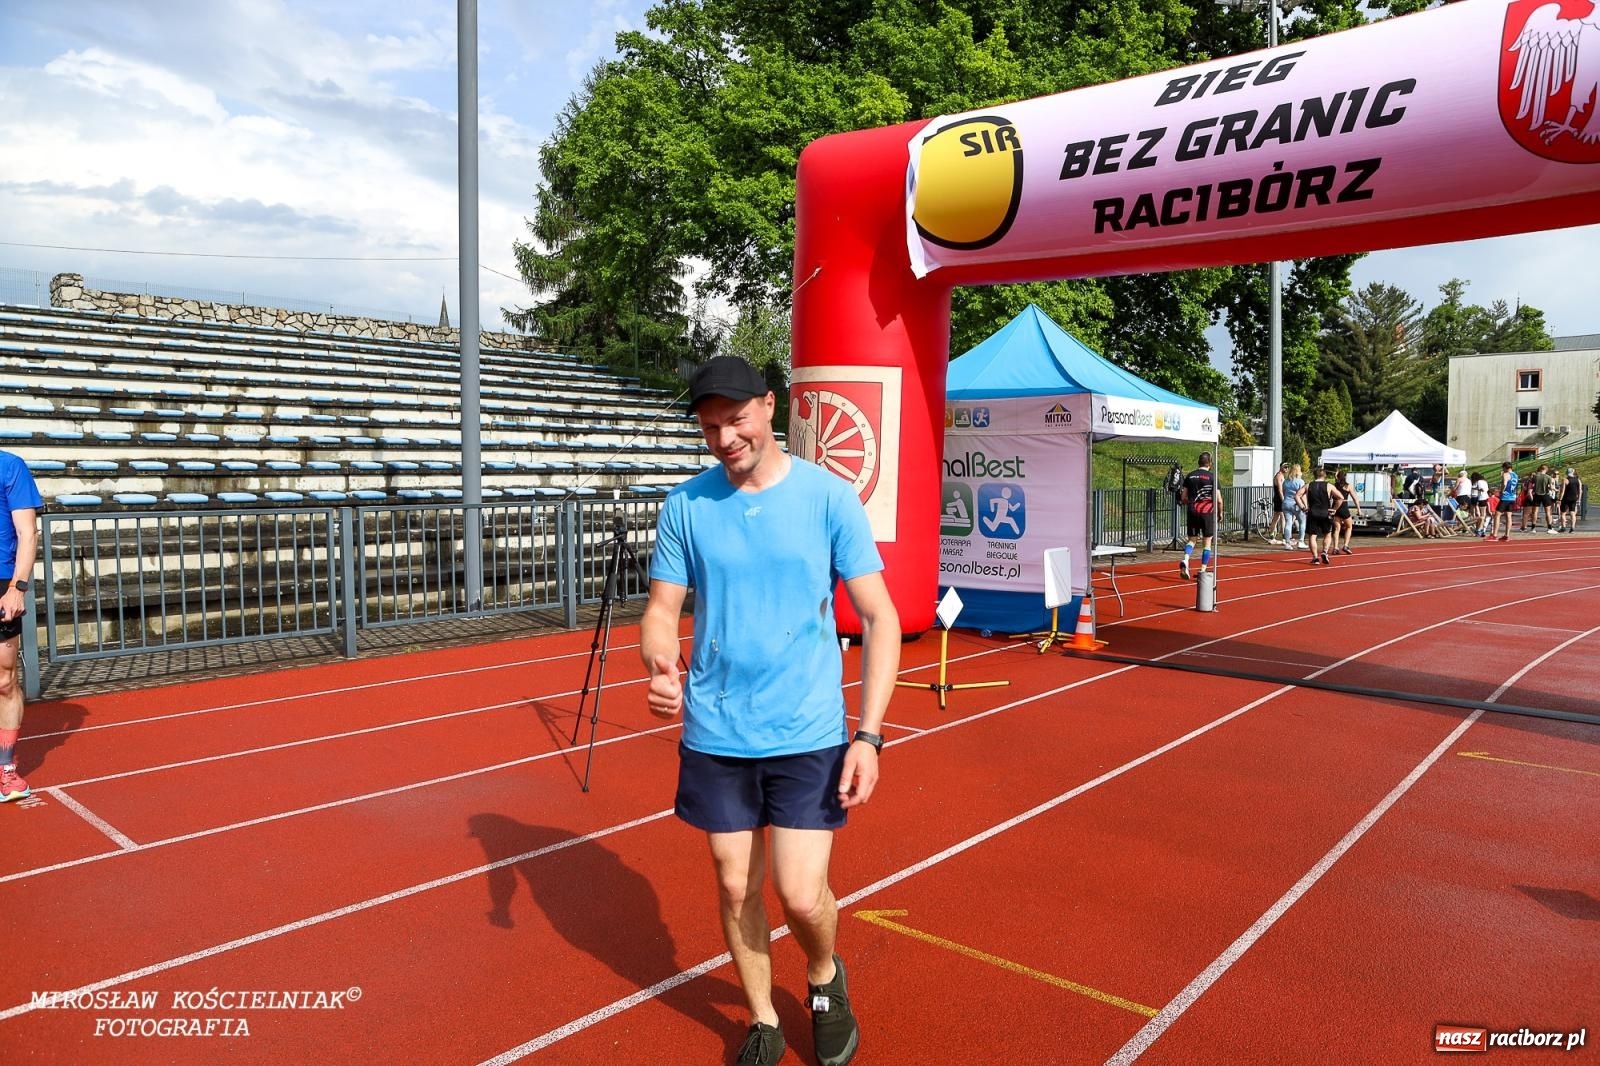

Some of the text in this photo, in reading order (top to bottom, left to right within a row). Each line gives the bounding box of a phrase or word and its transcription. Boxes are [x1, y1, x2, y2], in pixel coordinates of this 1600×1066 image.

[1154, 50, 1307, 107] BIEG
[960, 126, 1022, 157] SIR
[1059, 78, 1417, 180] BEZ GRANIC
[1092, 157, 1382, 234] RACIBÓRZ
[1044, 413, 1072, 423] MITKO
[986, 551, 1018, 560] BIEGOWE
[987, 541, 1017, 550] TRENINGI
[939, 561, 1021, 580] sonalbest.pl
